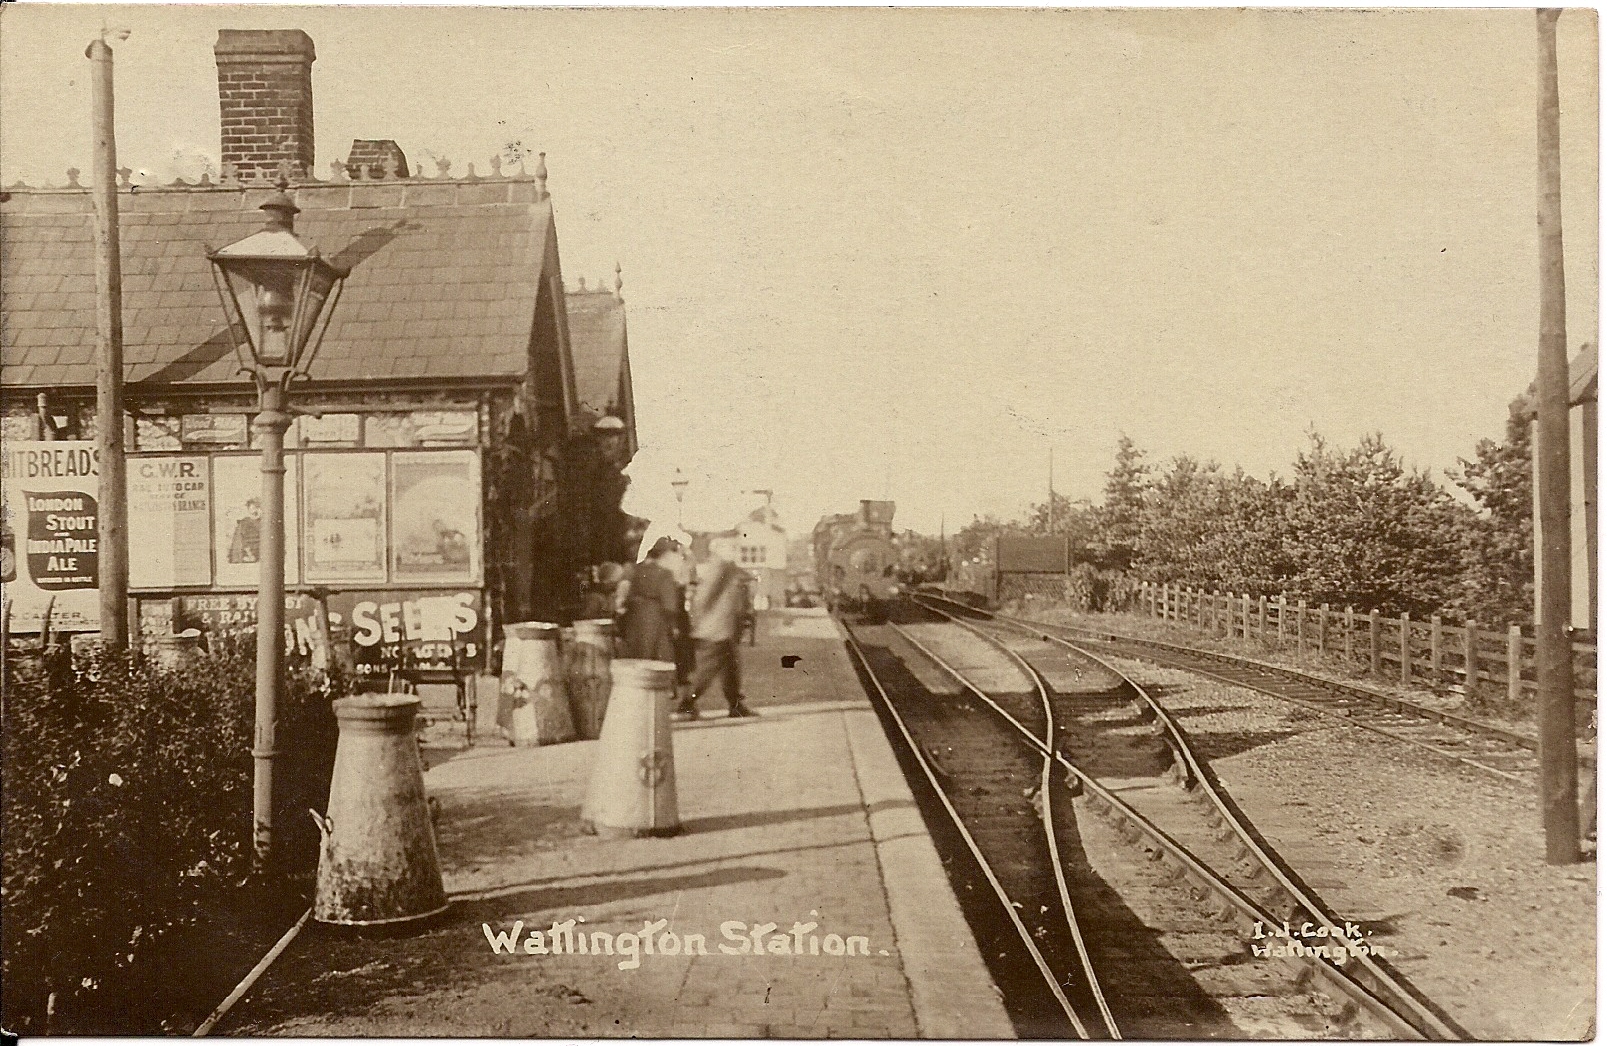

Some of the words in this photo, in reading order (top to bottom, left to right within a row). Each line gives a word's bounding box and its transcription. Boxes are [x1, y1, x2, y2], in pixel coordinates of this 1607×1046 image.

[29, 497, 83, 512] LONDON
[45, 514, 96, 531] STOUT
[47, 556, 79, 571] ALE
[186, 596, 231, 611] FREE
